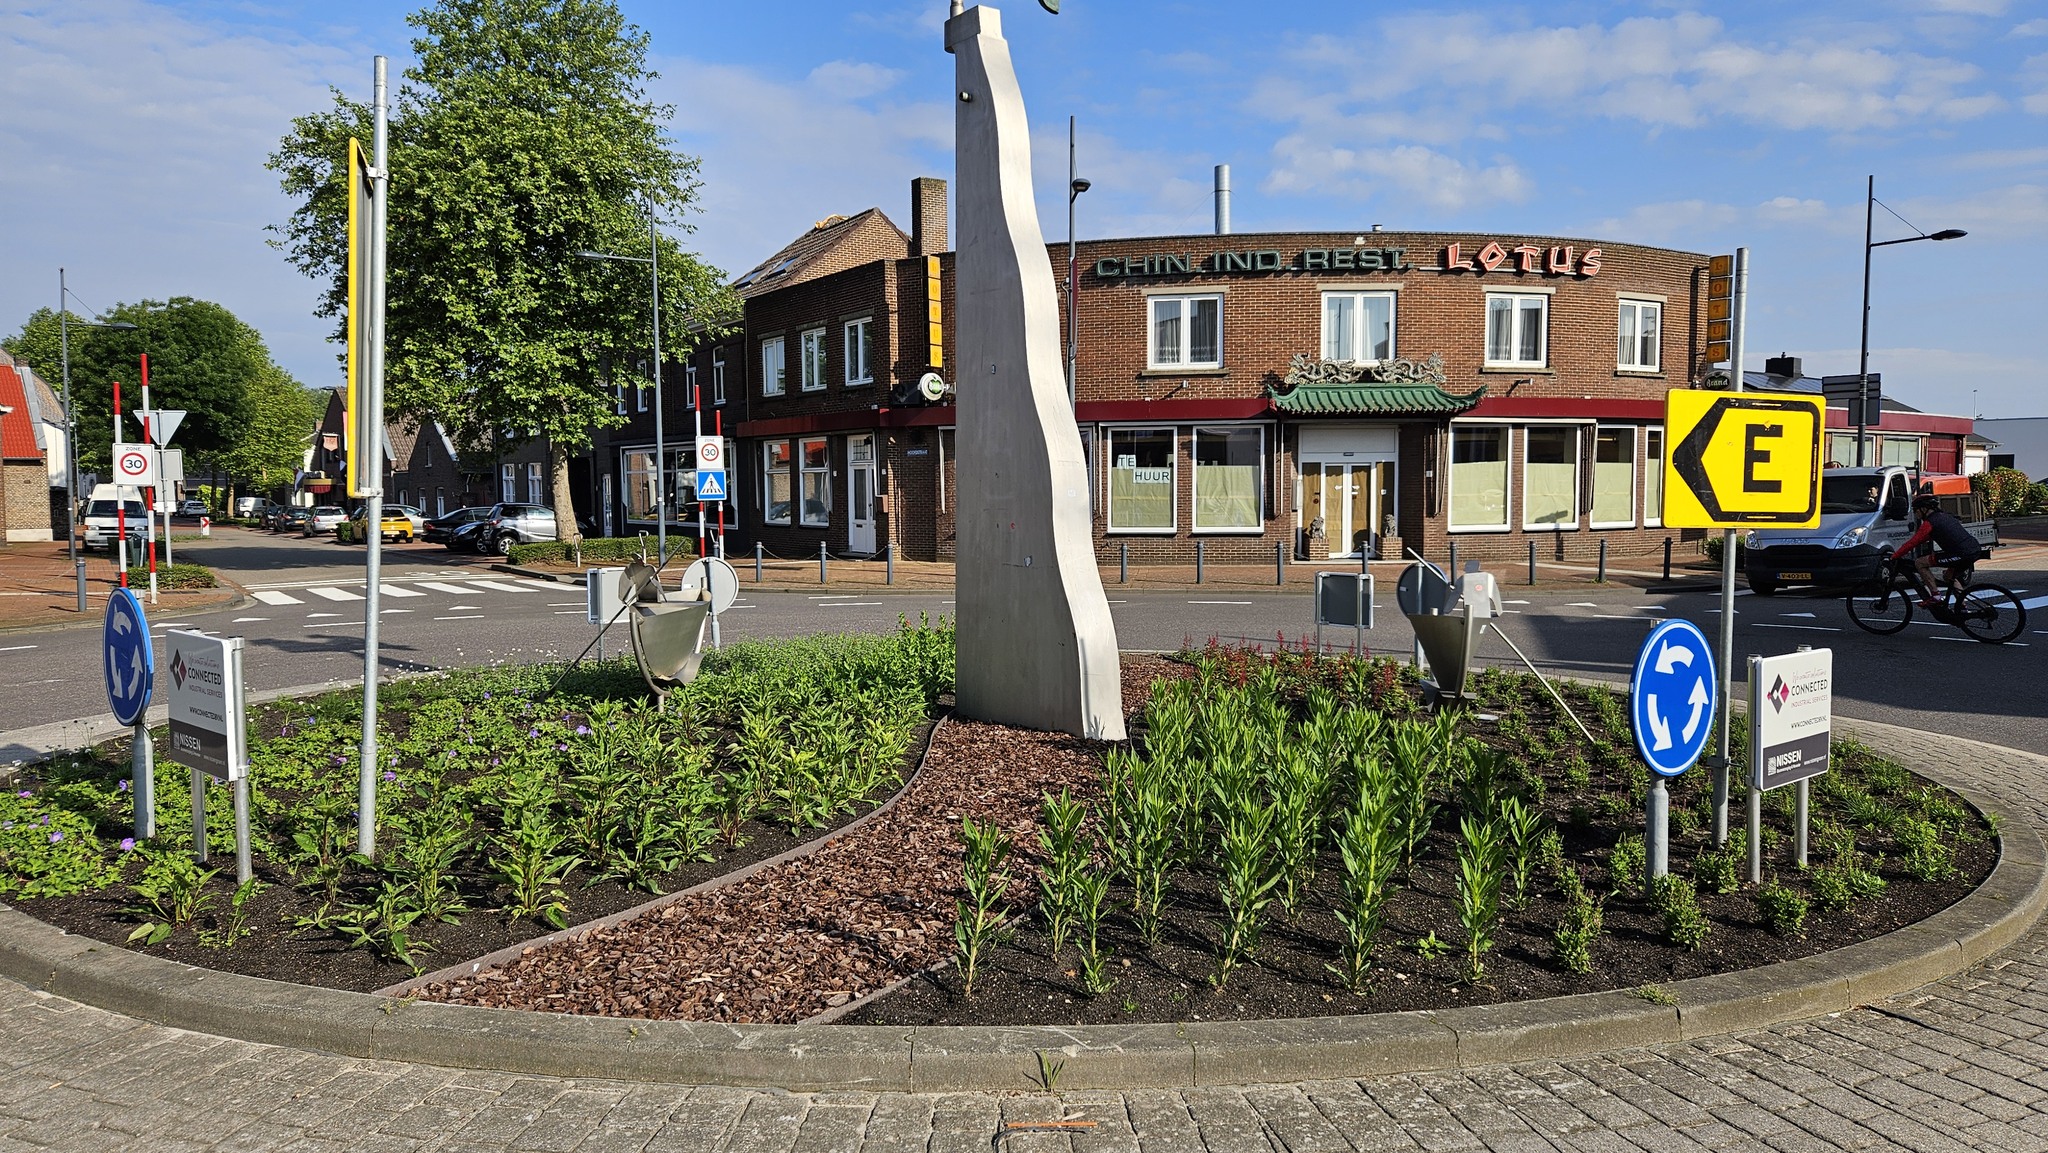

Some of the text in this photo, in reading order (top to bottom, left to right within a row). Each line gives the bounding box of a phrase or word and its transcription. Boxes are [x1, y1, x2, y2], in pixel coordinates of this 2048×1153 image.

[1096, 248, 1414, 277] CHIN. IND. REST.
[1446, 240, 1602, 276] LOTUS
[1712, 261, 1723, 357] LOTUS
[1706, 378, 1728, 388] Brand
[704, 448, 716, 457] 30
[1743, 423, 1783, 493] E
[125, 459, 142, 469] 30
[1119, 457, 1135, 467] TE
[1135, 471, 1170, 481] HUUR
[187, 667, 222, 686] CONNECTED
[1791, 679, 1828, 696] CONNECTED
[1812, 695, 1828, 704] SERVICES
[179, 733, 201, 751] NISSEN
[1776, 749, 1802, 768] NISSEN
